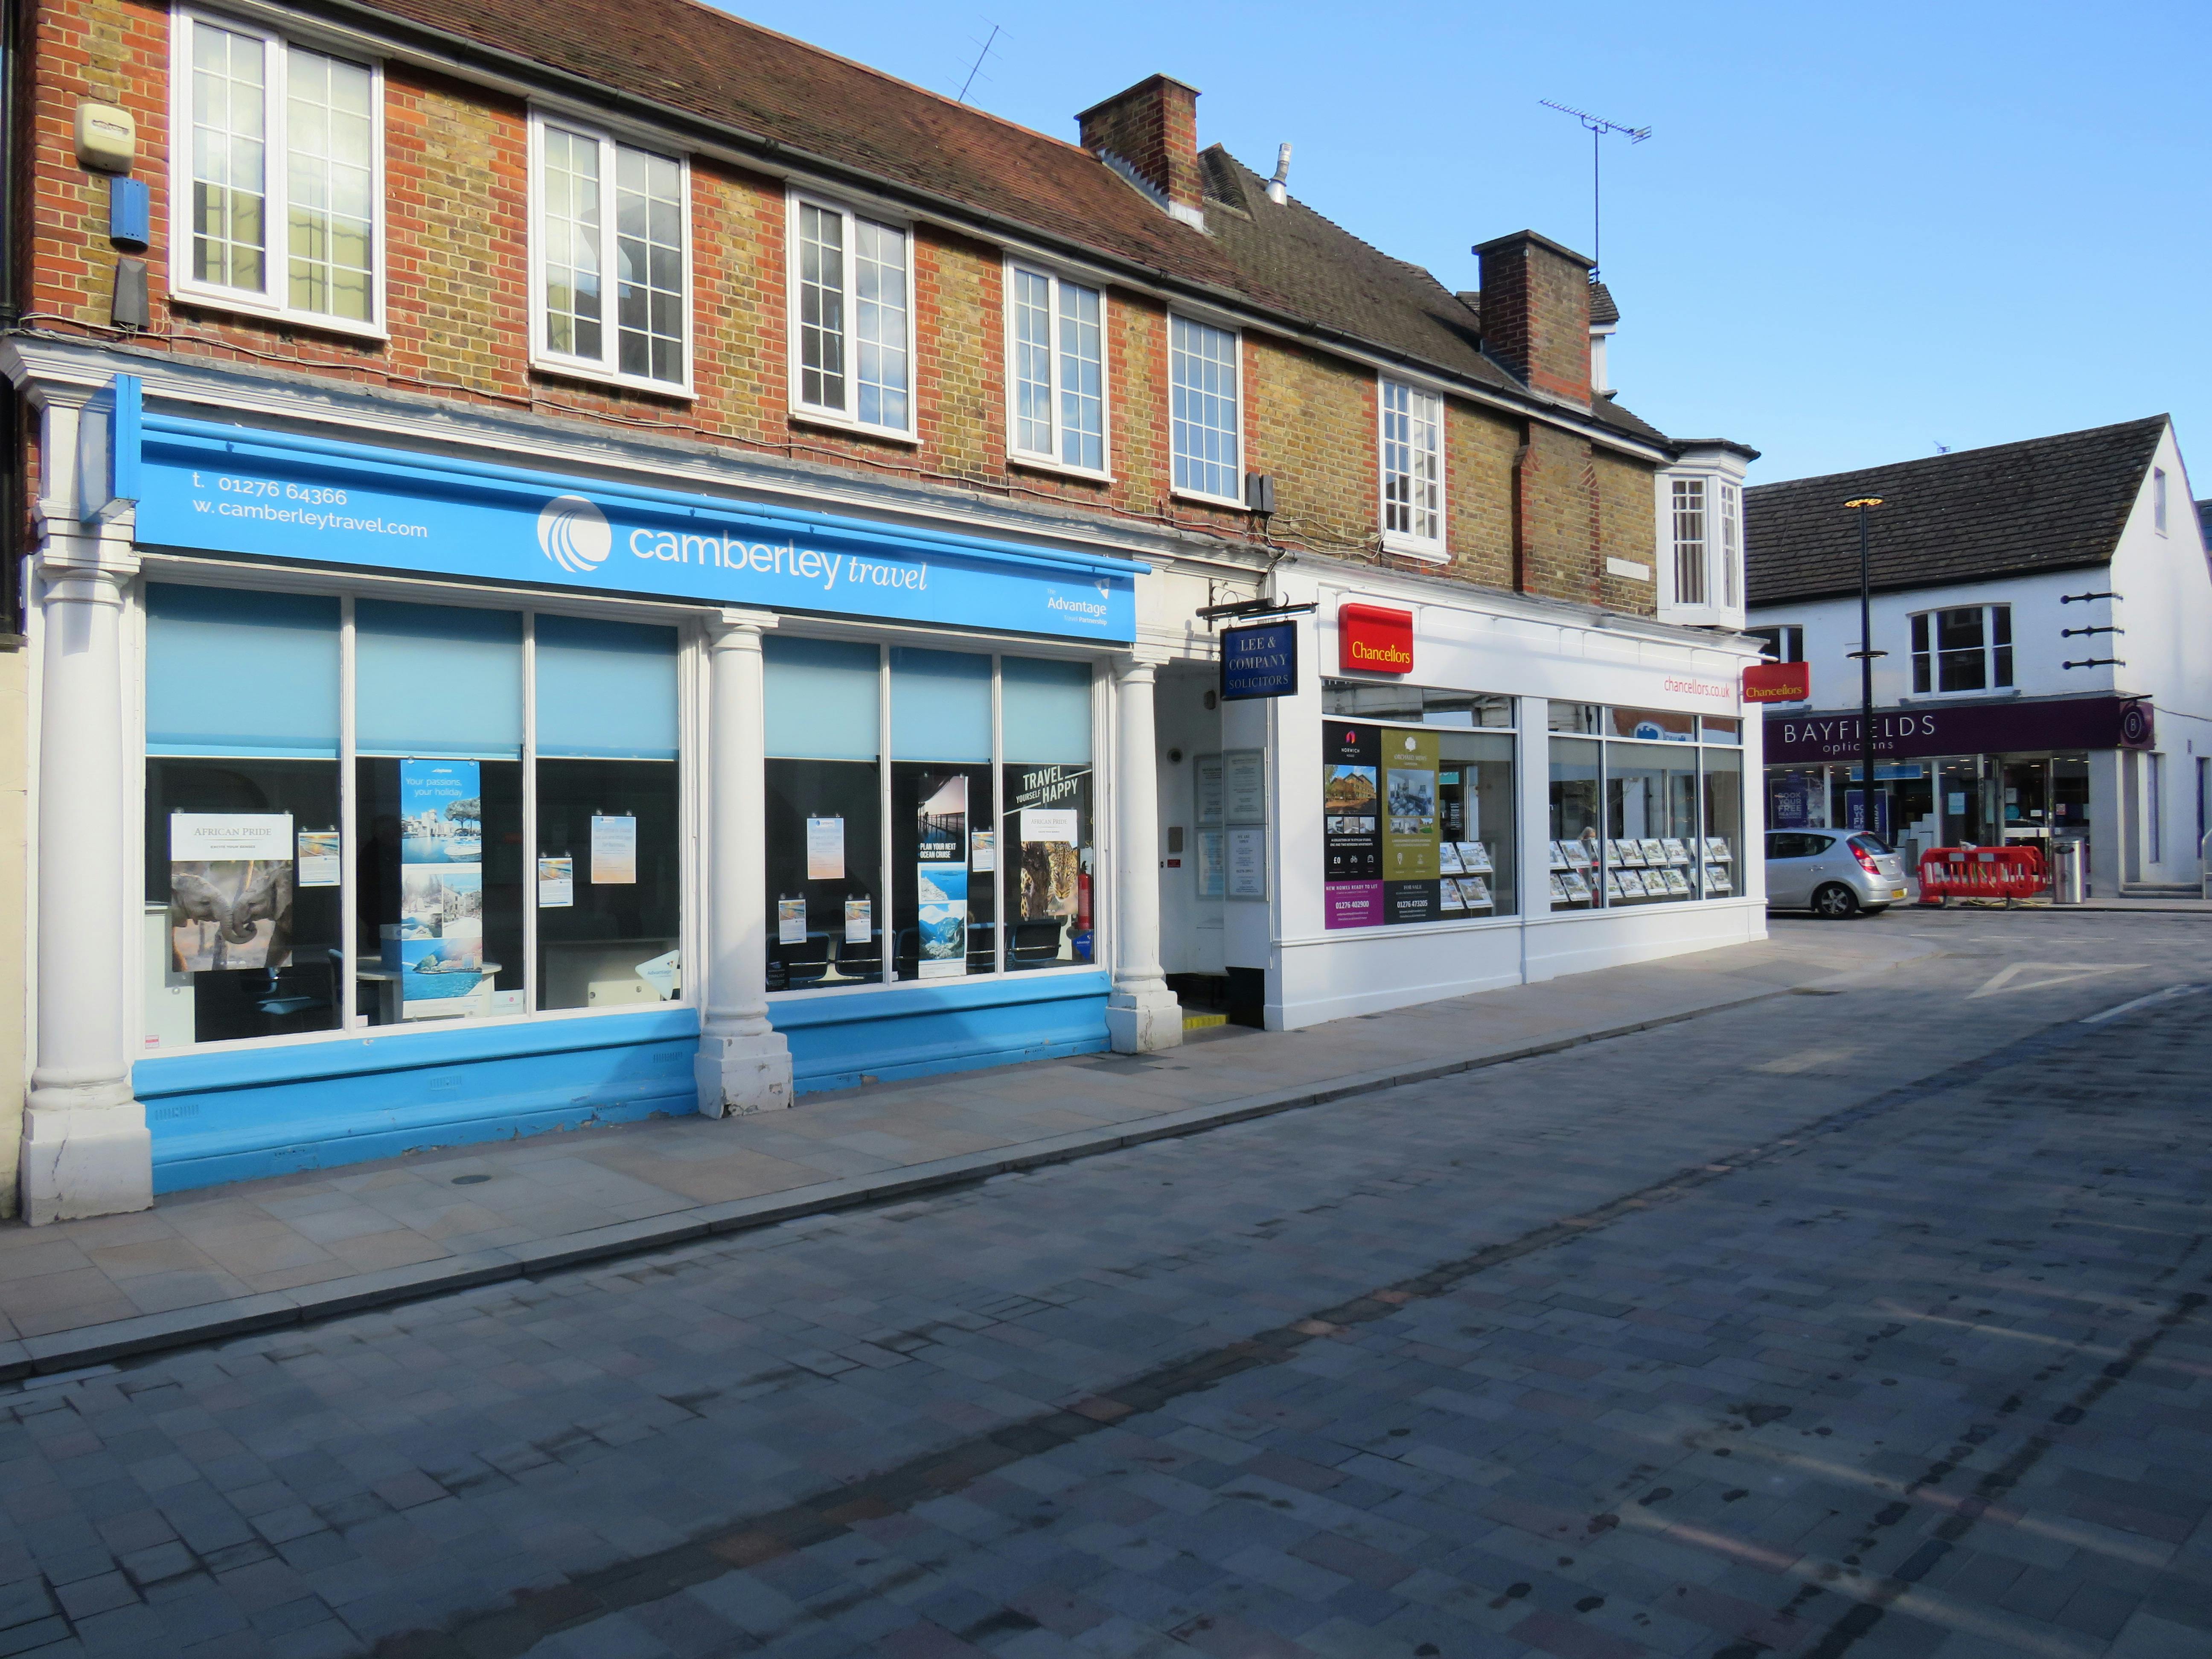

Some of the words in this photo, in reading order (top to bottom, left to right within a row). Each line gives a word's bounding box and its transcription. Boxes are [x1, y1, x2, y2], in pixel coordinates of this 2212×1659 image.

[192, 472, 204, 488] t.
[218, 476, 279, 498] 01276
[286, 483, 347, 506] 64366
[193, 500, 215, 514] w.
[218, 501, 428, 538] camberleytravel.com
[629, 527, 842, 590] camberley
[849, 556, 928, 591] travel
[1048, 597, 1106, 617] Advantage
[1079, 617, 1107, 626] Partnership
[1241, 637, 1264, 651] LEE
[1268, 636, 1276, 648] &
[1352, 641, 1410, 664] Chancellors
[1229, 653, 1287, 670] COMPANY
[1229, 674, 1288, 690] SOLICITORS
[1664, 675, 1730, 698] chancellors.co.uk
[1746, 684, 1803, 698] Chancellors
[427, 778, 462, 787] passions,
[1023, 765, 1064, 791] TRAVEL
[414, 789, 433, 797] your
[435, 788, 463, 797] holiday
[1016, 789, 1041, 803] YOURSELF
[1042, 777, 1078, 804] HAPPY
[194, 827, 240, 836] AFRICAN
[242, 827, 272, 836] PRIDE
